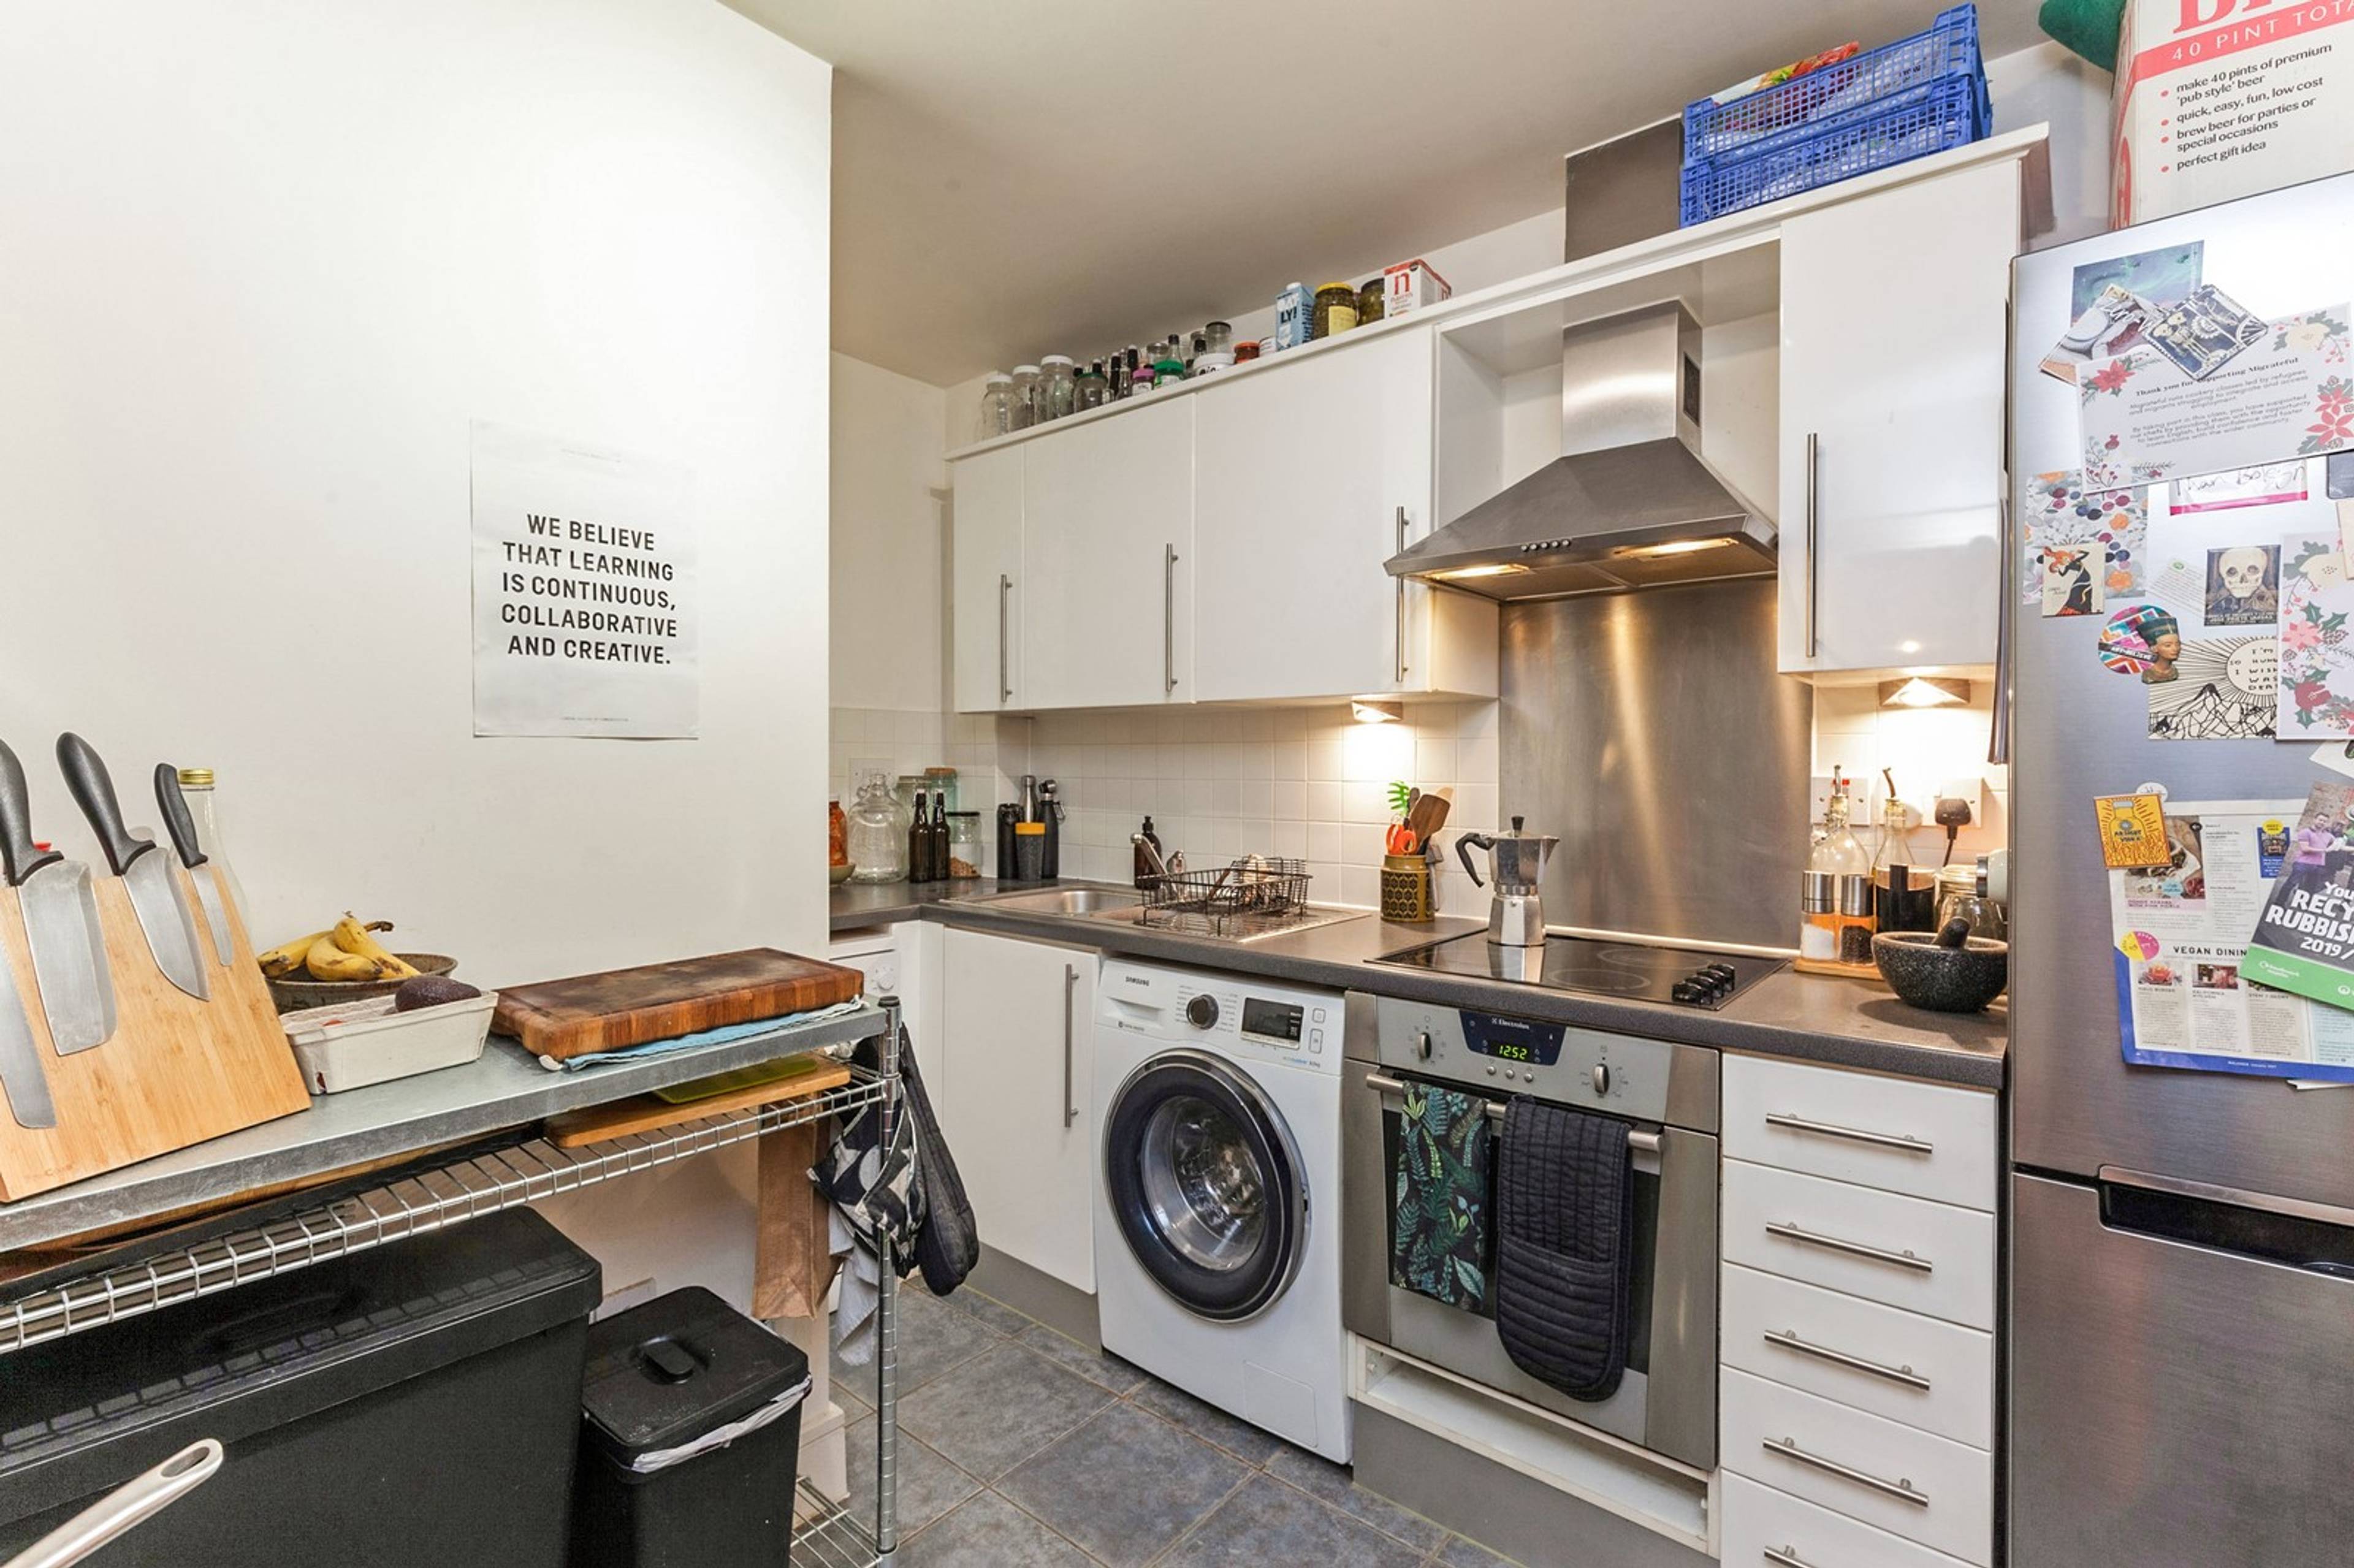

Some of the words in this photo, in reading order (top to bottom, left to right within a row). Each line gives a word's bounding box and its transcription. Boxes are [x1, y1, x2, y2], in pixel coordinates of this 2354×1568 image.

[2172, 42, 2201, 60] 40
[2216, 20, 2279, 48] PINT
[2177, 77, 2209, 93] make
[2211, 71, 2226, 83] 40
[2229, 64, 2258, 81] pints
[2260, 55, 2274, 70] of
[2275, 44, 2332, 68] premium
[2238, 74, 2266, 89] beer
[2177, 106, 2212, 124] quick,
[2214, 98, 2244, 114] easy,
[2246, 90, 2270, 104] fun,
[2272, 82, 2295, 98] low
[2296, 77, 2323, 92] cost
[2177, 125, 2207, 140] brew
[2208, 117, 2236, 133] beer
[2238, 110, 2256, 124] for
[2258, 102, 2299, 122] parties
[2301, 97, 2317, 109] or
[2177, 132, 2217, 153] special
[2219, 120, 2279, 141] occasions
[2177, 150, 2218, 171] perfect
[2220, 145, 2239, 161] gift
[2241, 140, 2267, 154] idea
[1281, 306, 1297, 324] LY!
[2136, 386, 2162, 396] Thank
[2164, 382, 2180, 393] you
[2249, 357, 2299, 372] Migrateful
[527, 514, 561, 537] WE
[569, 520, 655, 550] BELIEVE
[503, 541, 562, 567] THAT
[570, 551, 674, 581] LEARNING
[503, 572, 524, 592] IS
[532, 576, 676, 611] CONTINUOUS,
[501, 604, 677, 637] COLLABORATIVE
[508, 635, 555, 657] AND
[564, 639, 671, 664] CREATIVE.
[2173, 946, 2211, 955] VEGAN
[2216, 948, 2247, 956] DININ
[1125, 975, 1150, 986] SAMSUNG
[1499, 1018, 1530, 1029] Electrolux
